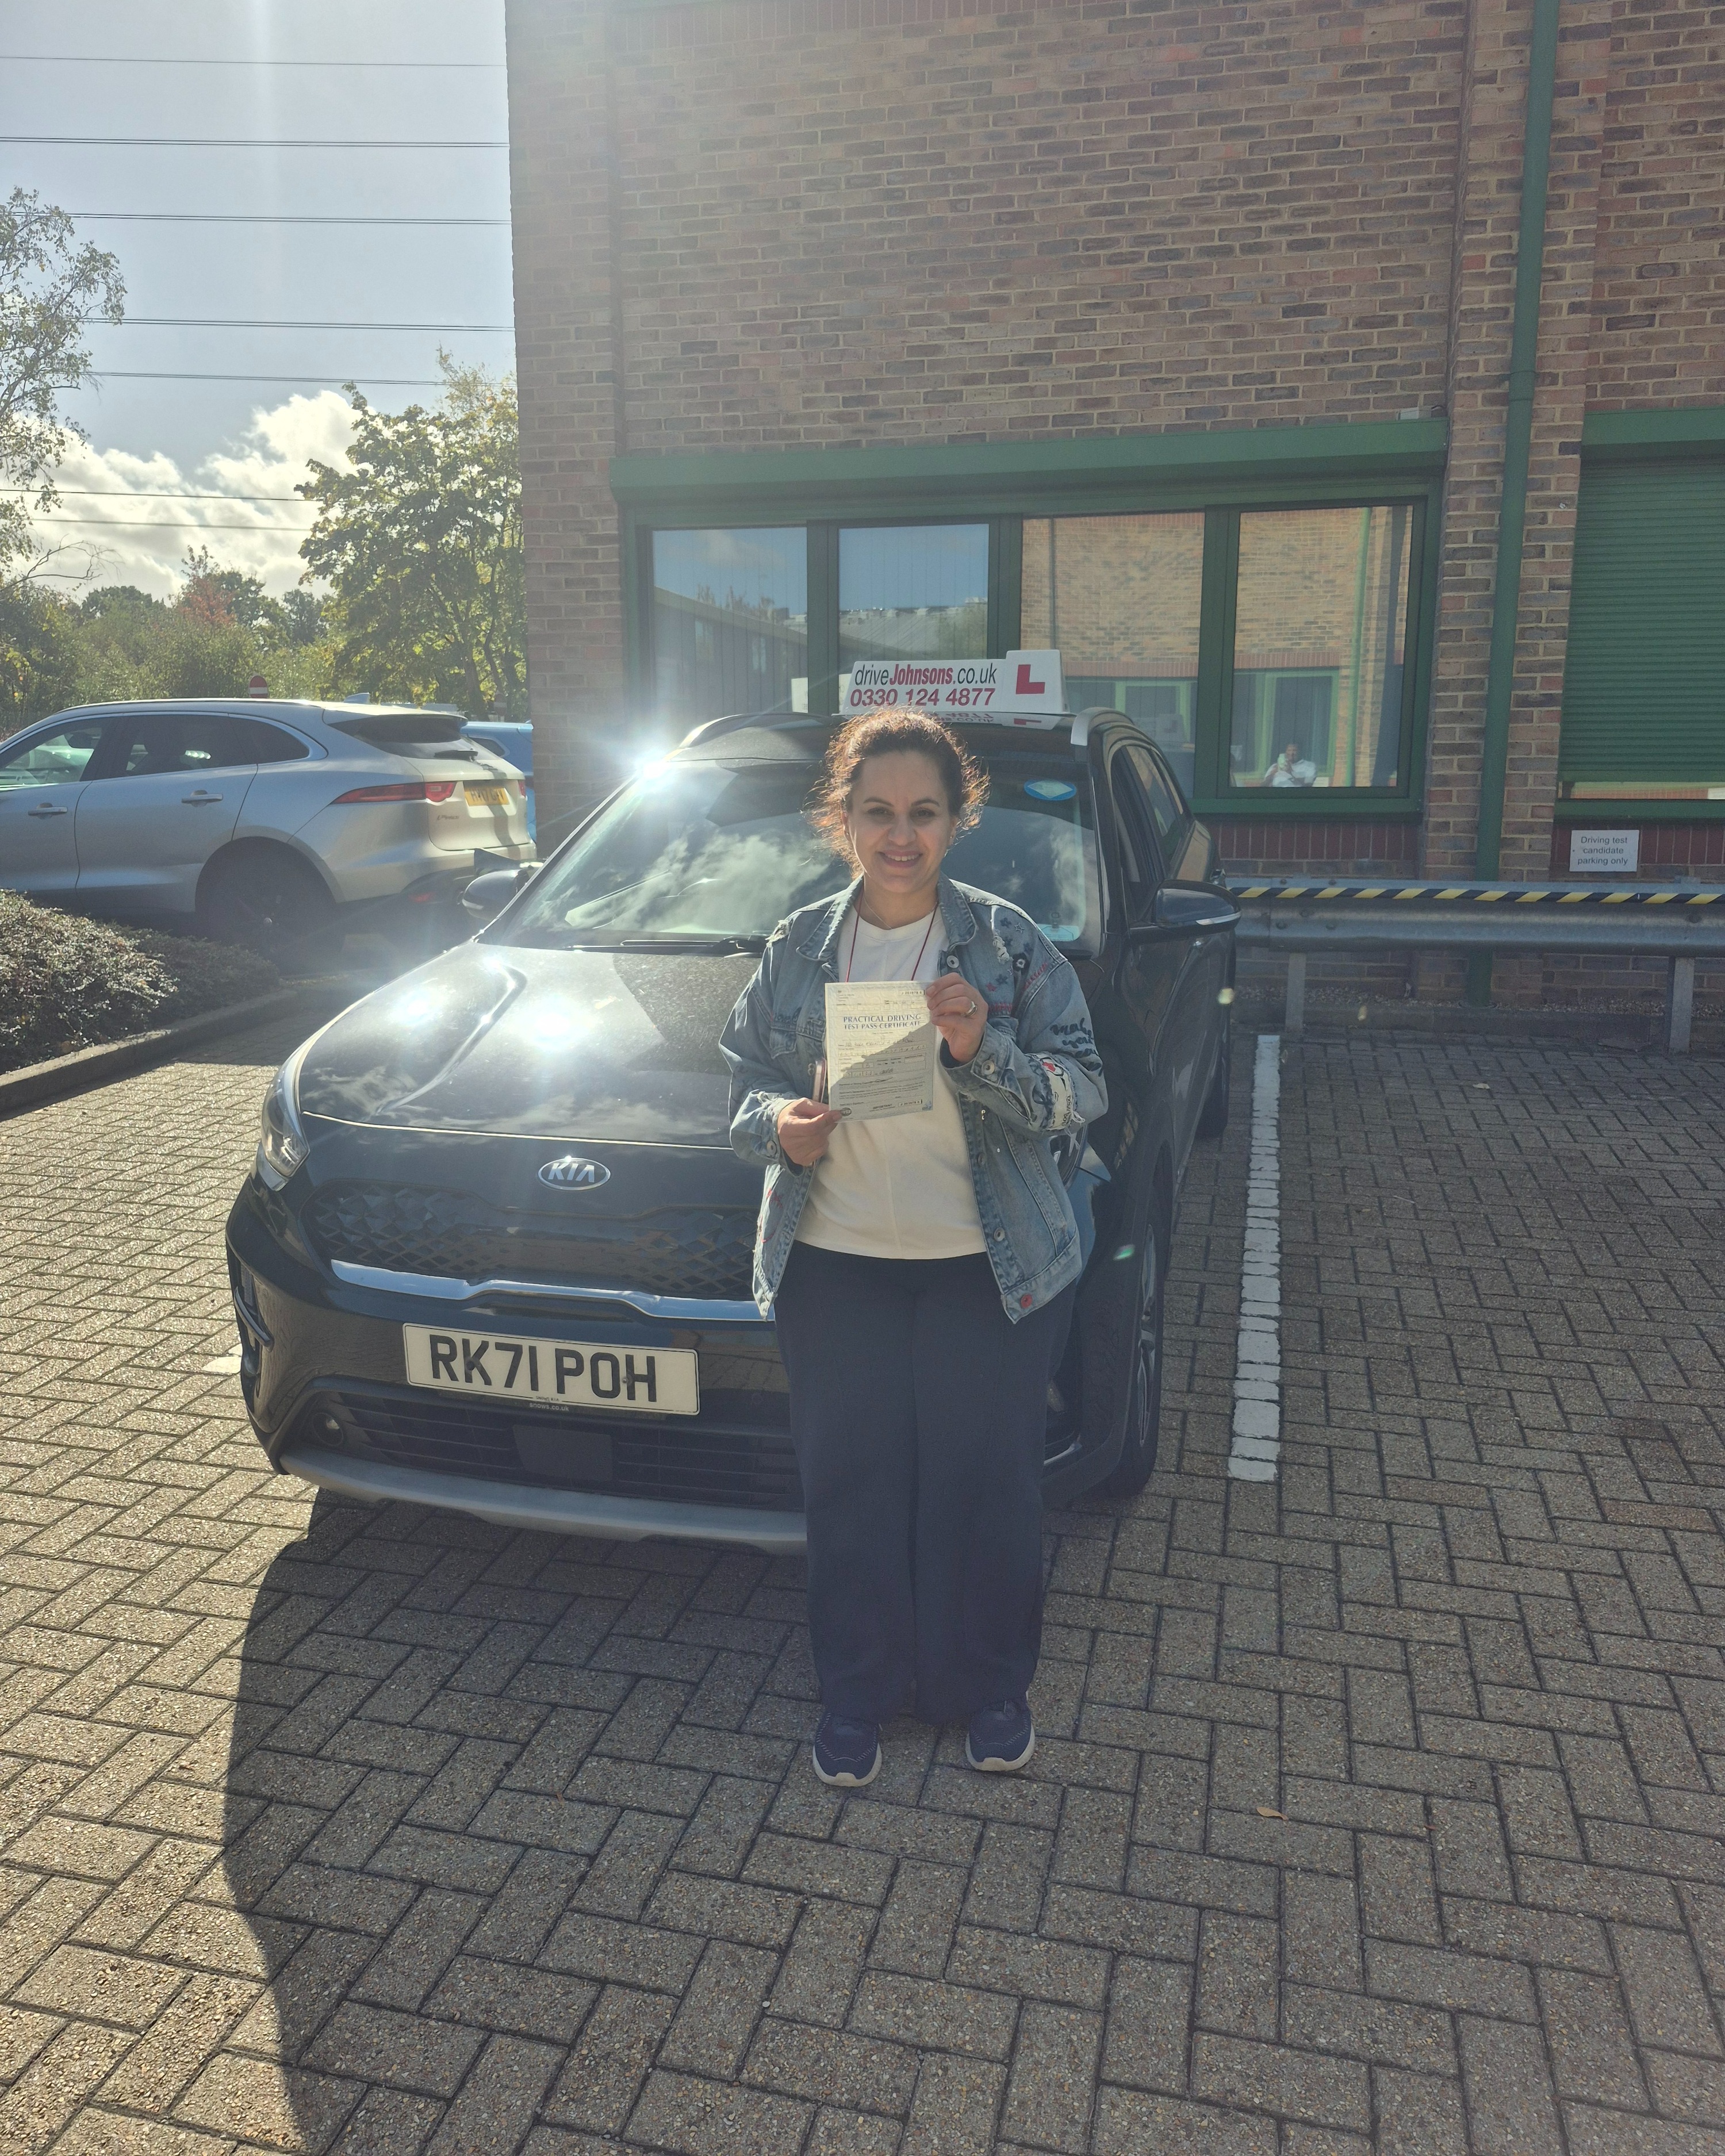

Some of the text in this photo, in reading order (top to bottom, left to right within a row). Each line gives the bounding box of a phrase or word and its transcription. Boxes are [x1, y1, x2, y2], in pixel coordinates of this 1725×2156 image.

[854, 663, 998, 686] driveJohnsons.co.uk
[1015, 664, 1045, 695] L
[850, 688, 898, 707] 0330
[905, 688, 939, 706] 124
[946, 688, 996, 706] 4877
[1581, 837, 1609, 845] Driving
[1578, 857, 1628, 866] parking only
[879, 1021, 921, 1029] CERTIFICATE
[887, 1014, 921, 1022] DRIVING
[548, 1163, 595, 1183] KIA
[429, 1334, 657, 1402] RK71 POH
[529, 1403, 569, 1411] snows.co.uk
